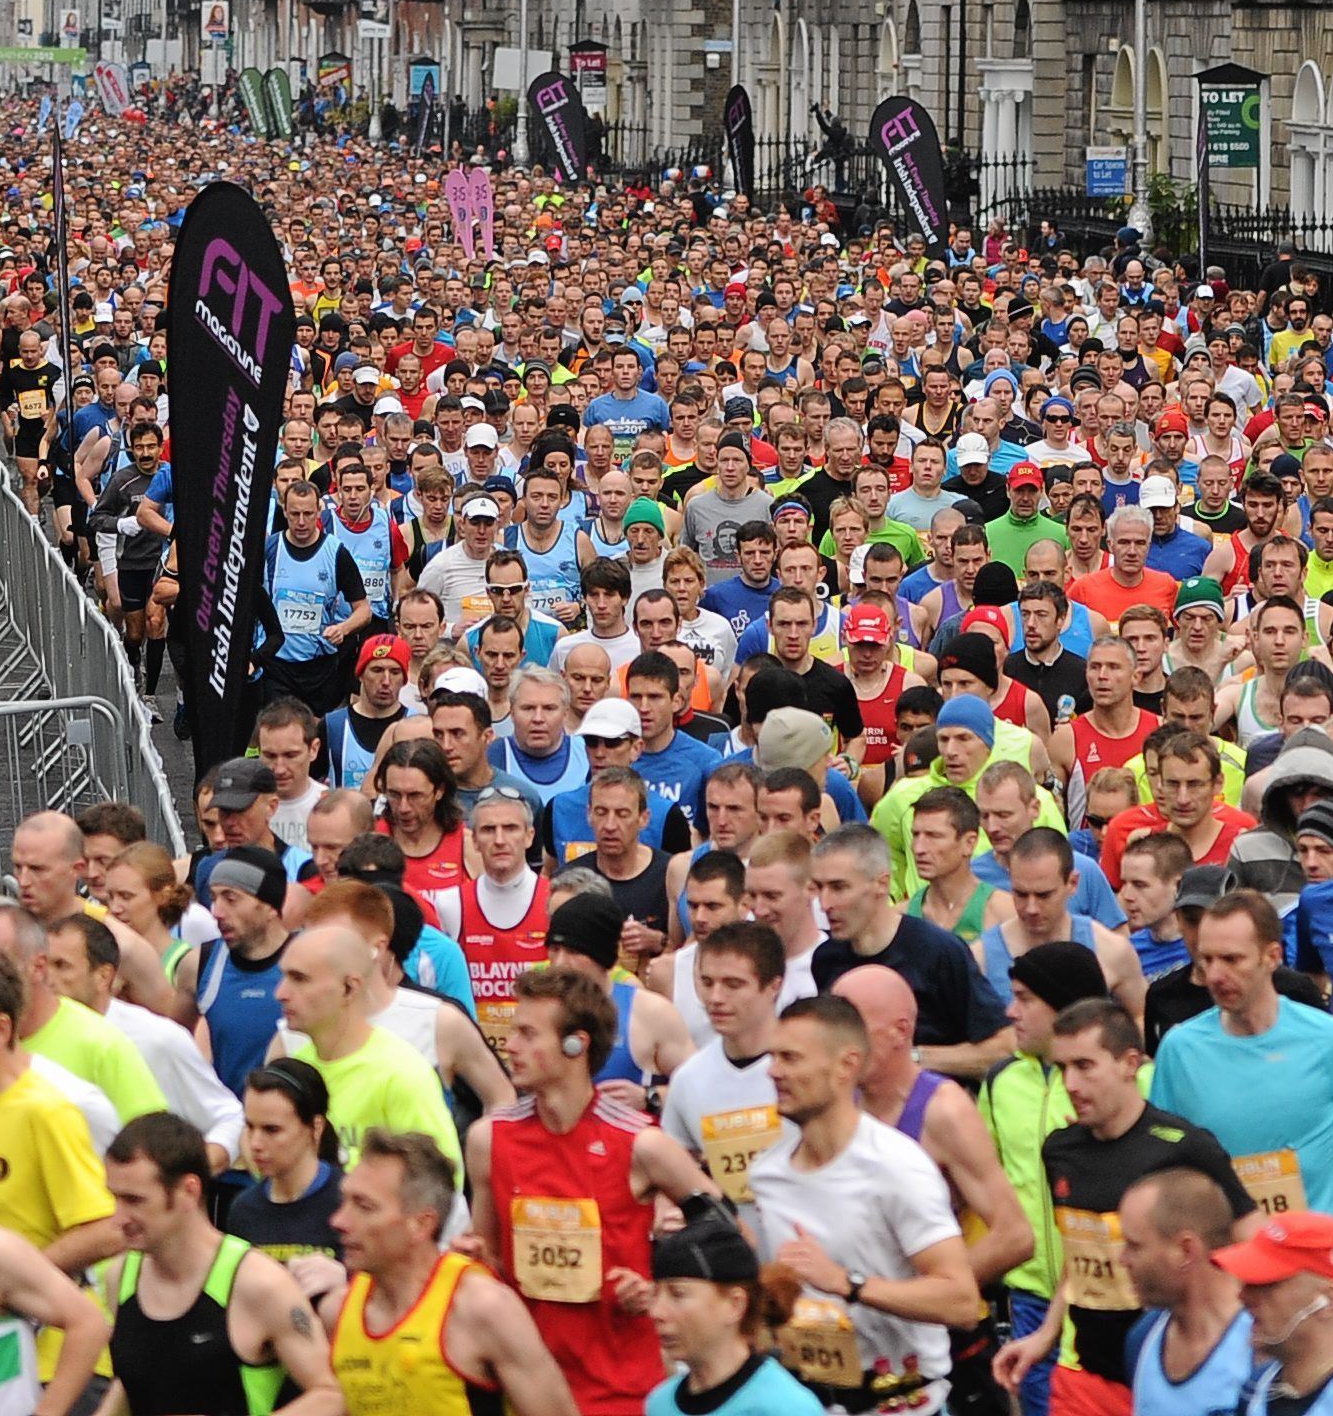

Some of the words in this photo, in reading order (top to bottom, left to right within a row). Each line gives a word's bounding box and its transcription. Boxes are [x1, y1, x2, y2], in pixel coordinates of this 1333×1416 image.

[536, 79, 567, 111] FIT
[1201, 91, 1220, 104] TO
[1221, 91, 1246, 103] LET
[881, 106, 919, 150] FIT
[903, 179, 933, 238] Independent
[198, 237, 284, 366] FIT
[195, 299, 264, 385] magazine
[212, 386, 241, 500] Thursday
[202, 510, 224, 583] Every
[217, 433, 259, 627] Independent
[196, 592, 211, 633] Out
[283, 607, 317, 621] 17752
[208, 628, 232, 700] Irish
[713, 1111, 768, 1129] DUBLIN
[528, 1245, 583, 1268] 3052
